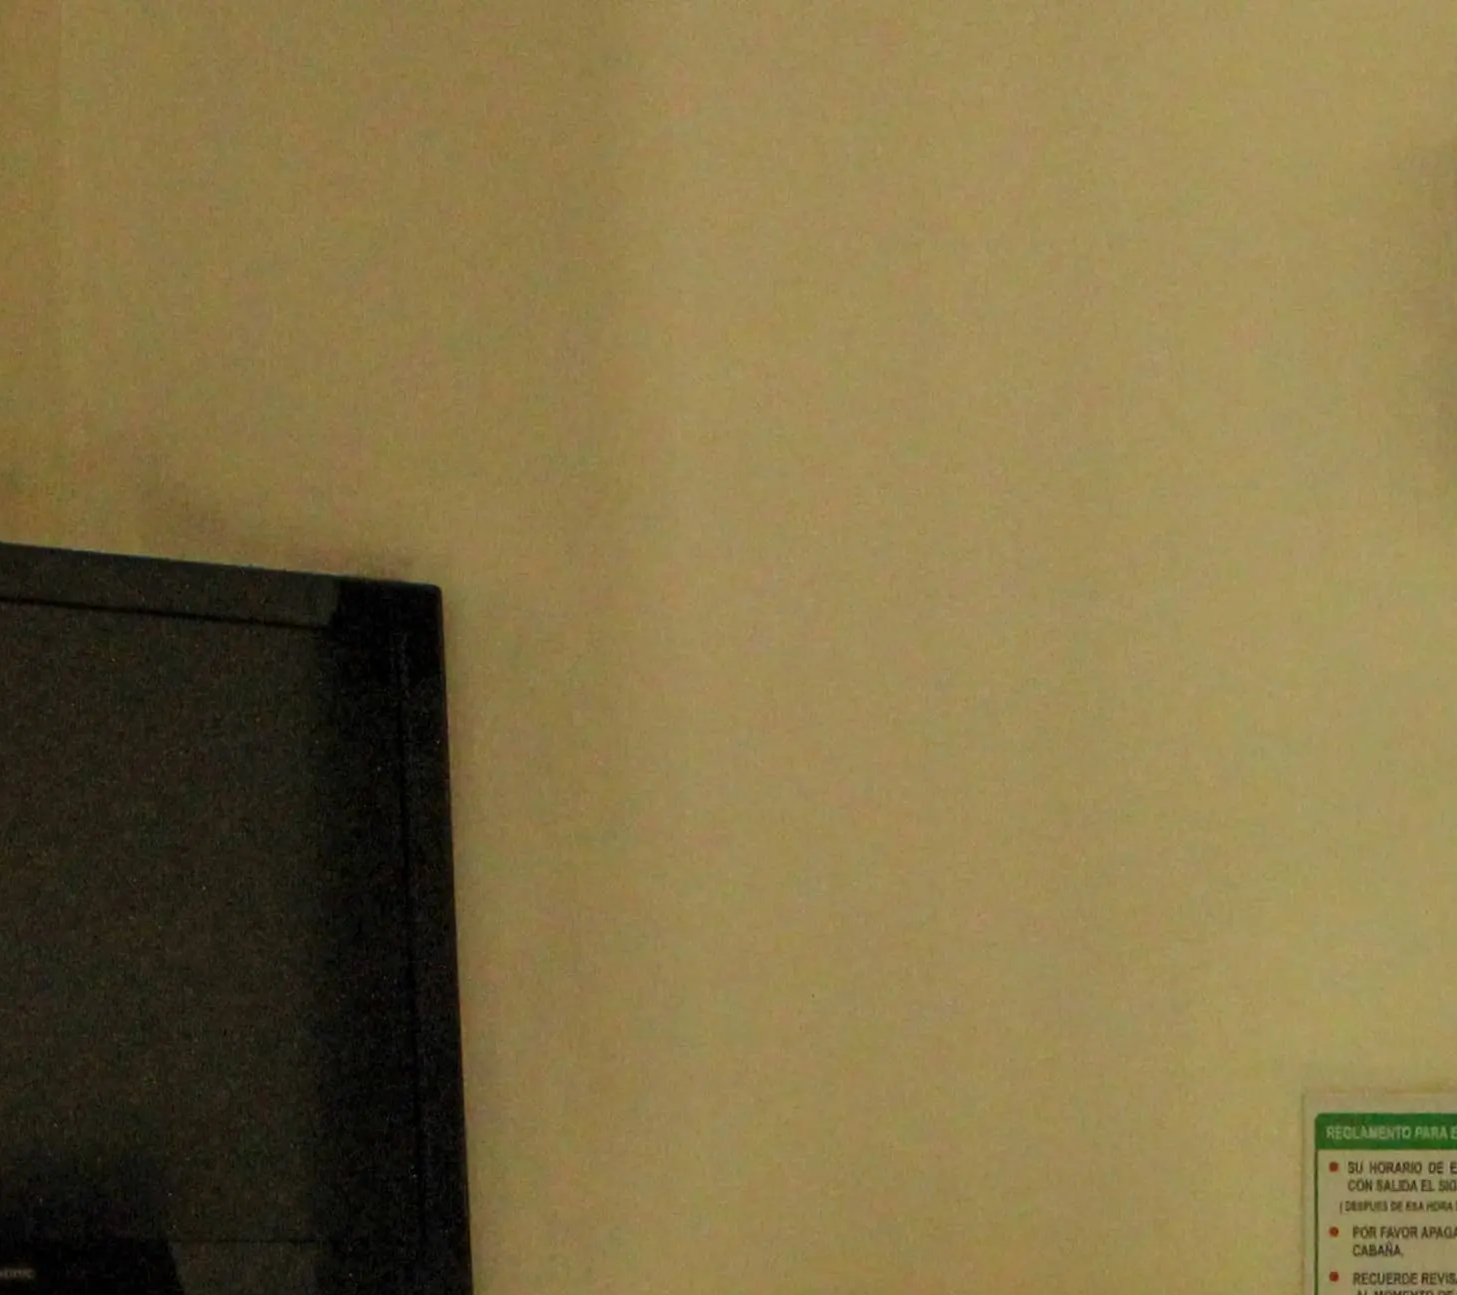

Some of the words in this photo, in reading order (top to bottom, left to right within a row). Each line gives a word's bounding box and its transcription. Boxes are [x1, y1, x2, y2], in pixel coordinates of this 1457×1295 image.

[1326, 1125, 1411, 1140] REGLAMENTO
[1414, 1125, 1448, 1140] PARA
[1347, 1161, 1363, 1174] SU
[1369, 1161, 1422, 1174] HORARIO
[1428, 1161, 1444, 1174] DE
[1347, 1180, 1373, 1192] CON
[1376, 1180, 1418, 1192] SALIDA
[1420, 1180, 1435, 1192] EL
[1352, 1226, 1377, 1239] POR
[1380, 1226, 1418, 1239] FAVOR
[1352, 1272, 1418, 1285] RECUERDE
